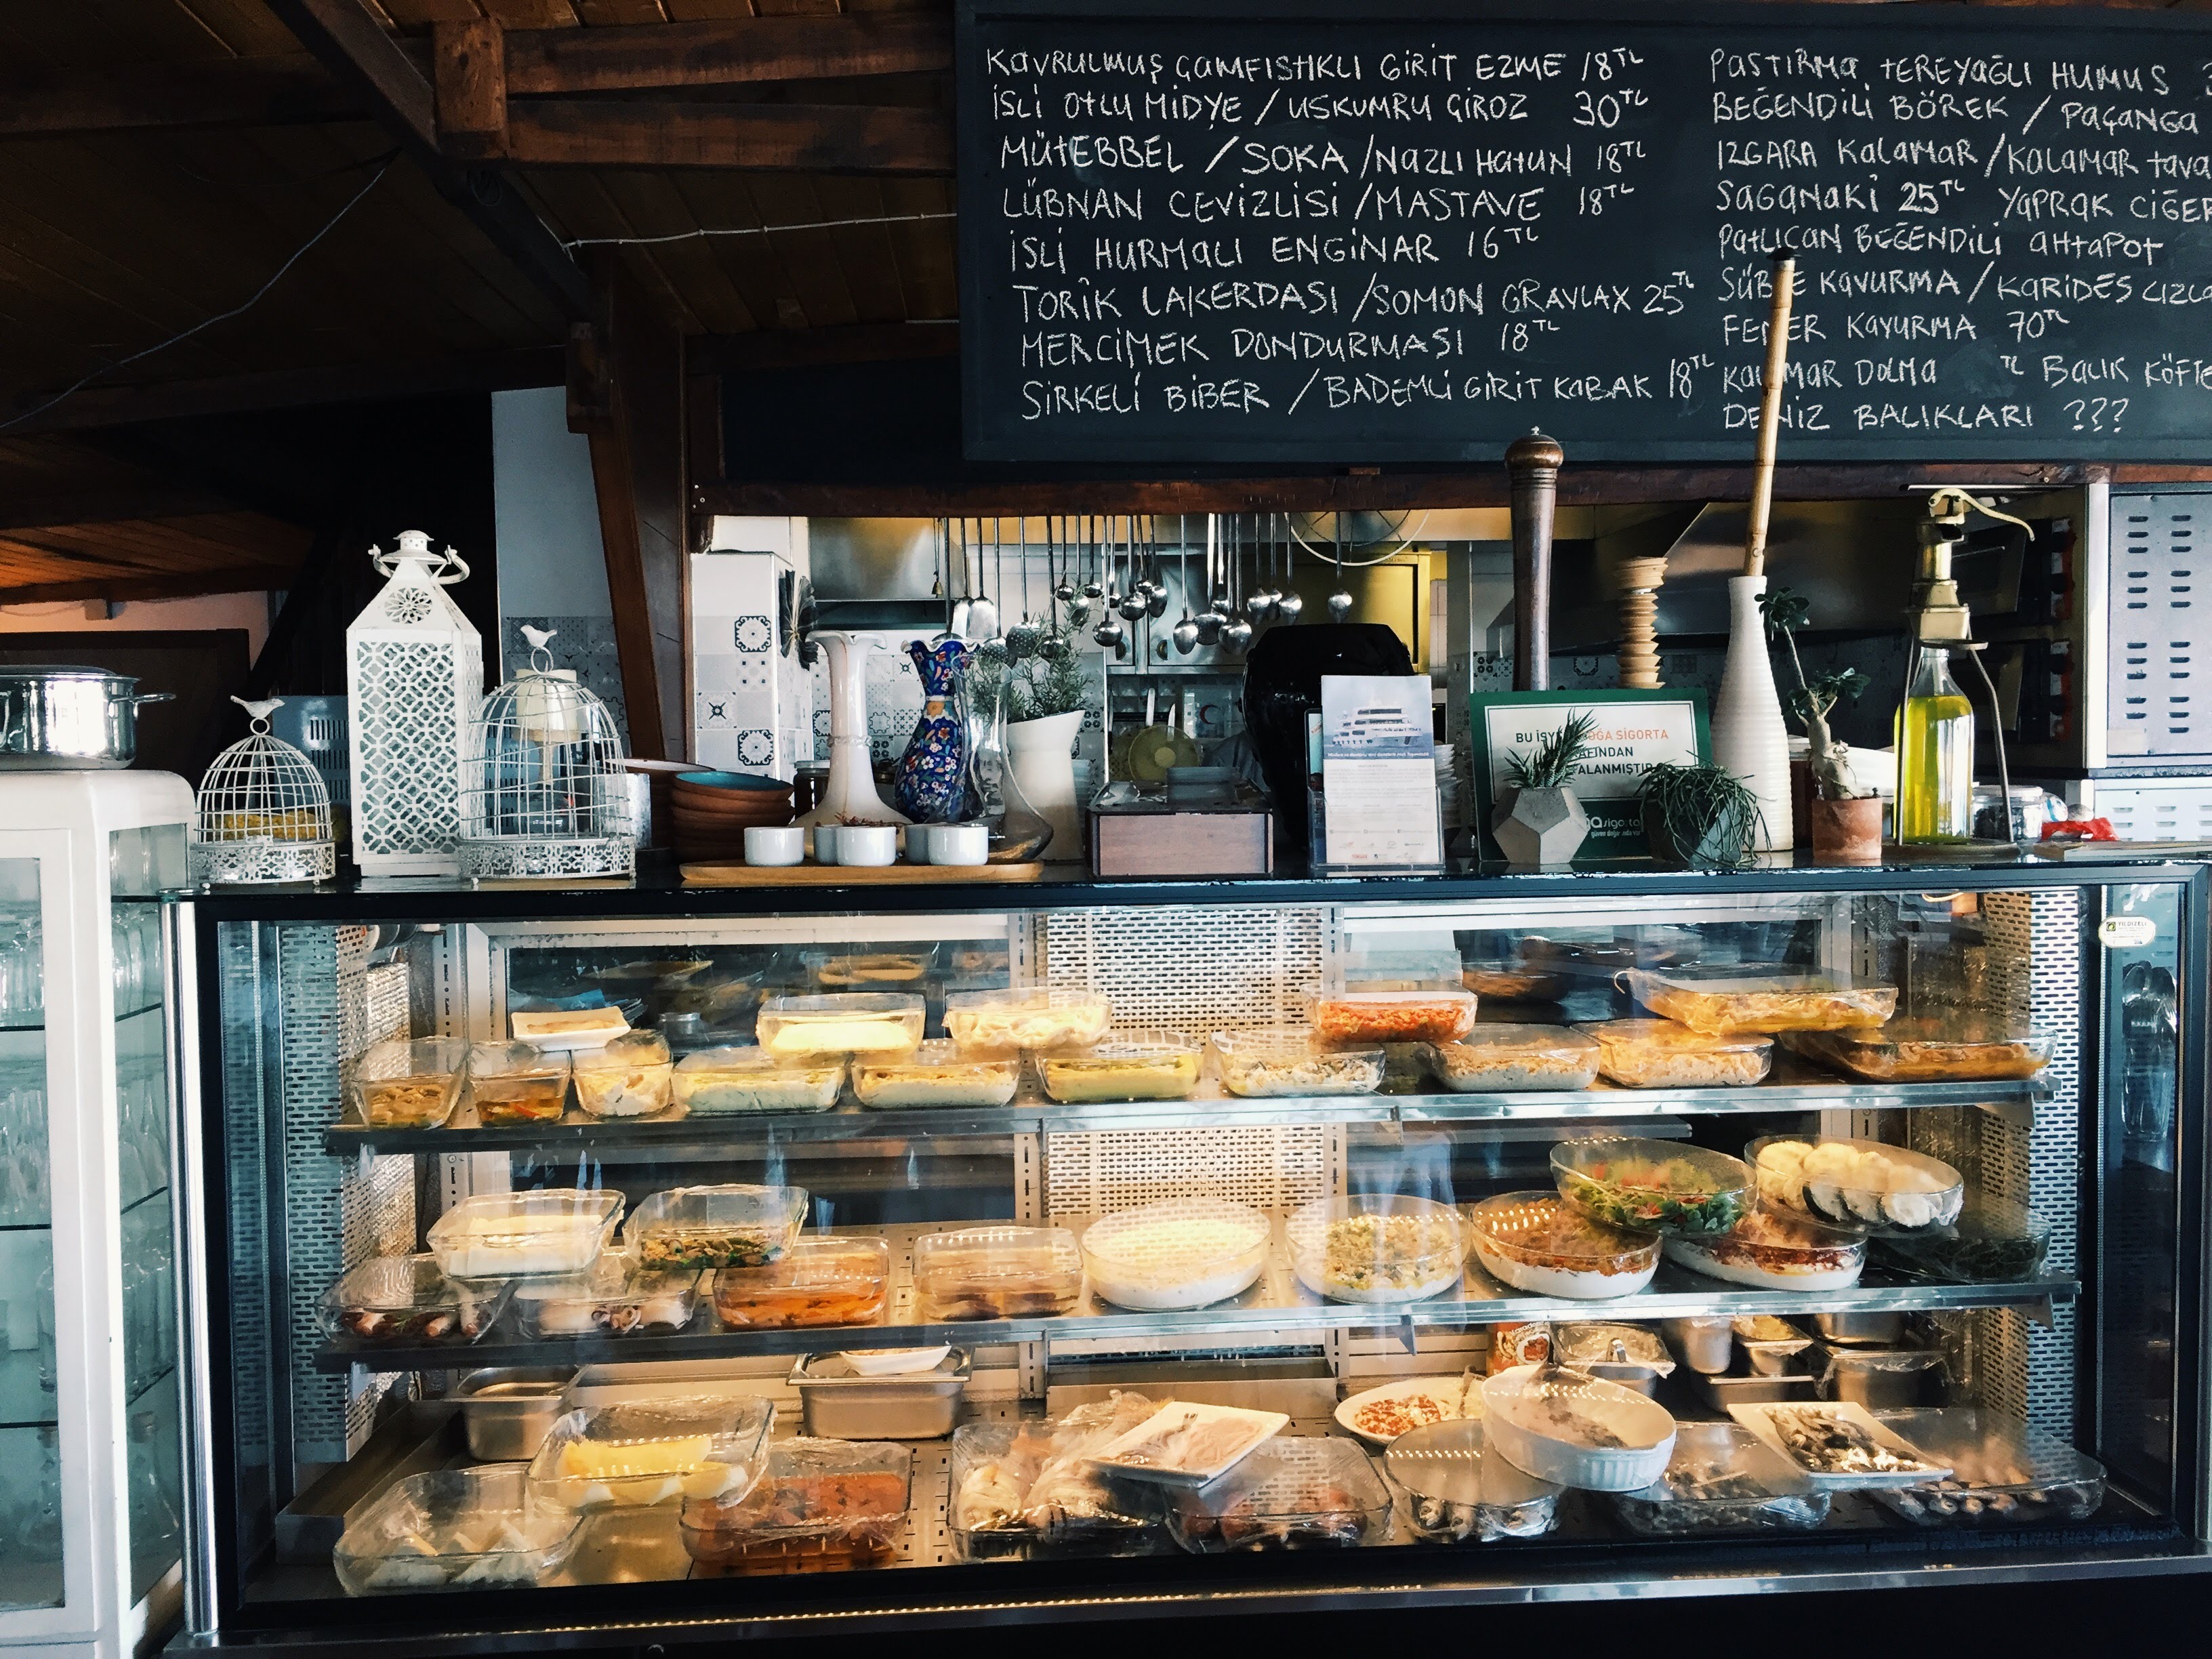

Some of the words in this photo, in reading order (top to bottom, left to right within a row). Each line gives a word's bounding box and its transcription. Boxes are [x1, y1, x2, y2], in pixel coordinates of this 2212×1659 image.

[1477, 54, 1566, 81] EZME
[2052, 62, 2169, 95] HUMUS
[1064, 91, 1133, 121] OTLU
[1838, 138, 1978, 166] KALAMAR
[1718, 263, 1805, 301] SÜBE
[1143, 281, 1337, 317] LAKERDASI
[1231, 327, 1462, 362] DONDURMASI
[1723, 360, 1843, 393] KALMAR
[1516, 733, 1532, 743] BU
[1616, 728, 1668, 739] SİGORTA
